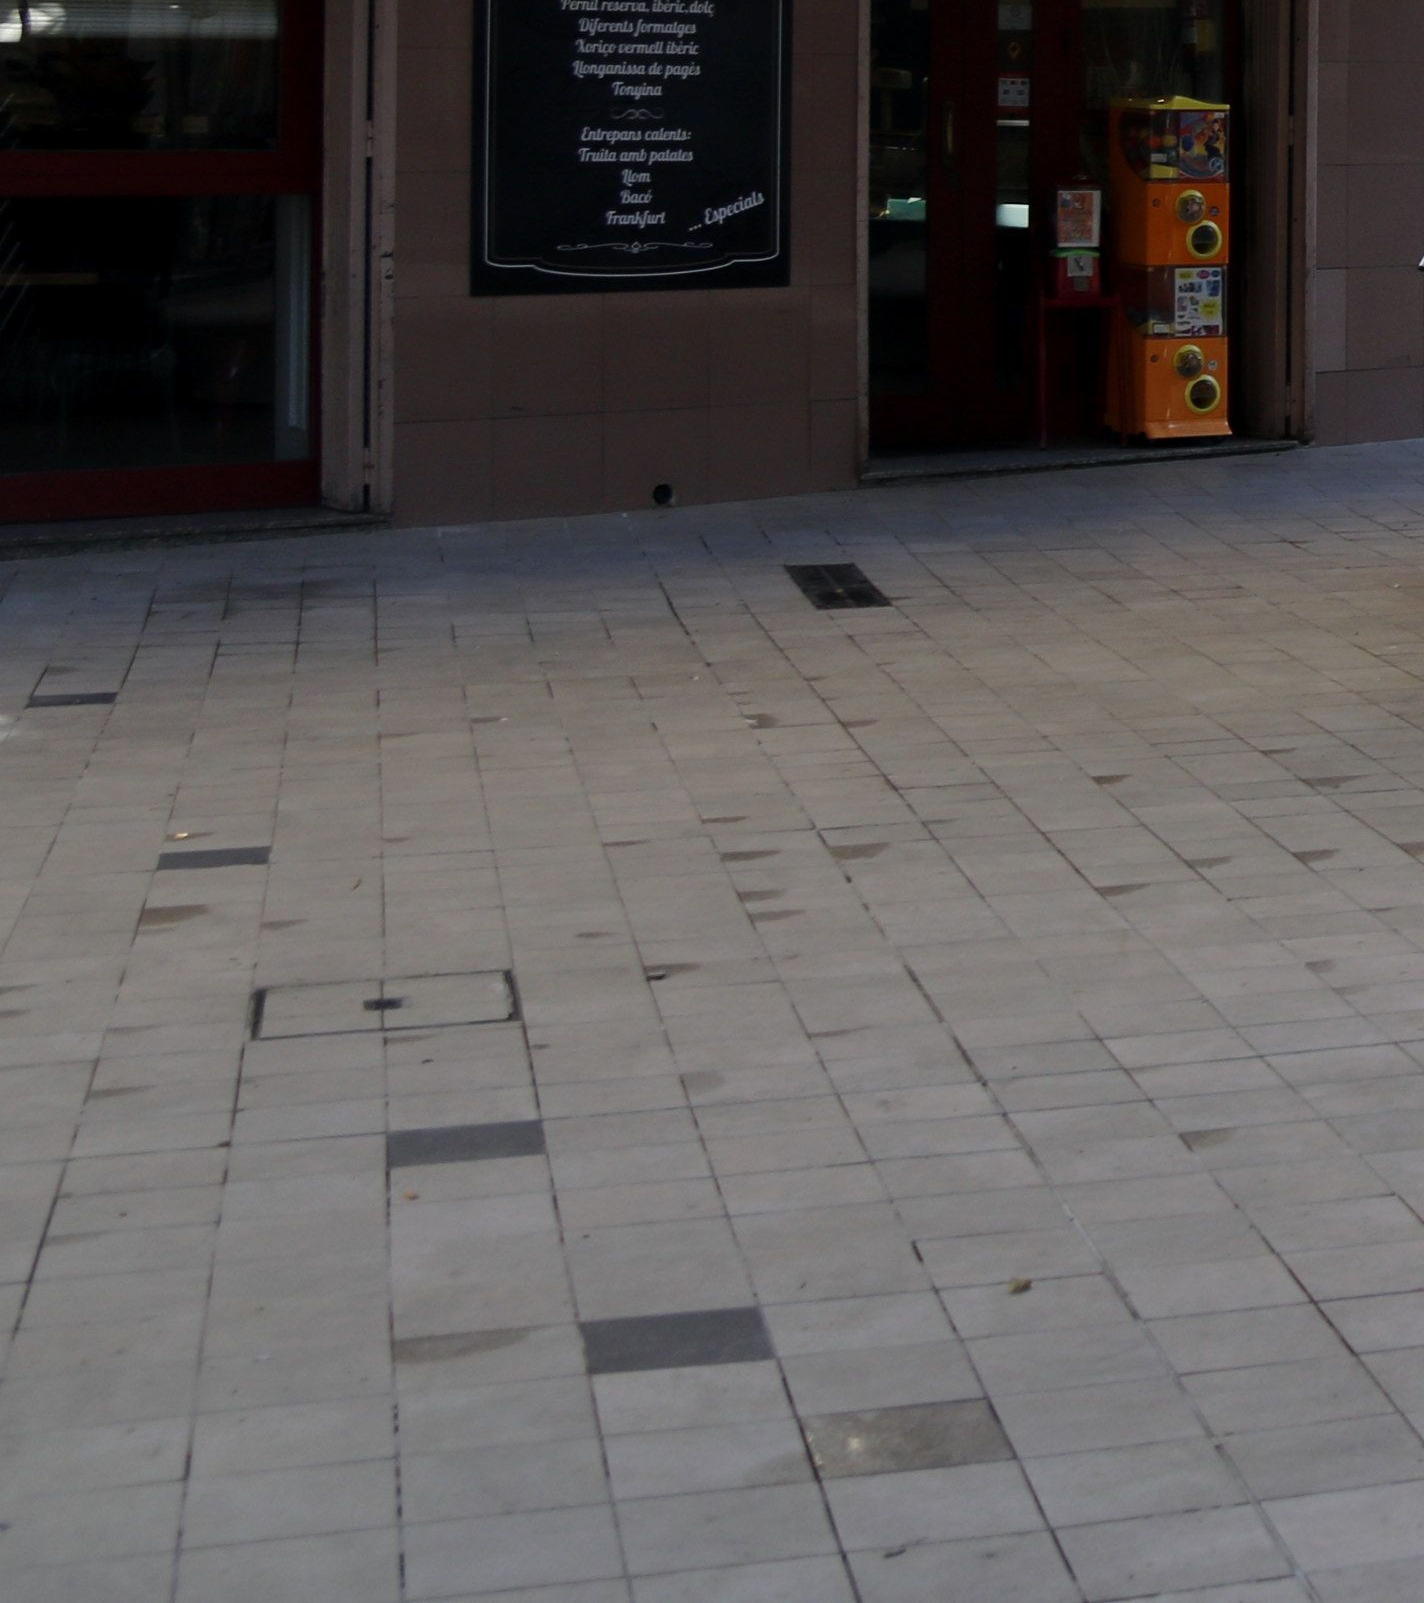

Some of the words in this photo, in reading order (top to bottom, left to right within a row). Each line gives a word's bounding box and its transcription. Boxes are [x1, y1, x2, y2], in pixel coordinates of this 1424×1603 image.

[579, 18, 633, 36] Diferents
[634, 19, 696, 37] formatges
[575, 38, 616, 57] Xoriço
[618, 41, 663, 54] vermell
[666, 41, 699, 55] ibèric
[572, 60, 645, 79] Llonganissa
[649, 62, 663, 75] de
[665, 62, 701, 80] pagès
[611, 82, 663, 100] Tonyina
[581, 127, 642, 144] Entrepans
[645, 128, 691, 141] calents:
[578, 148, 617, 162] Truita
[619, 149, 647, 162] amb
[648, 149, 694, 166] patates
[621, 169, 652, 187] Llom
[620, 189, 652, 204] Bacó
[606, 210, 666, 229] Frankfurt
